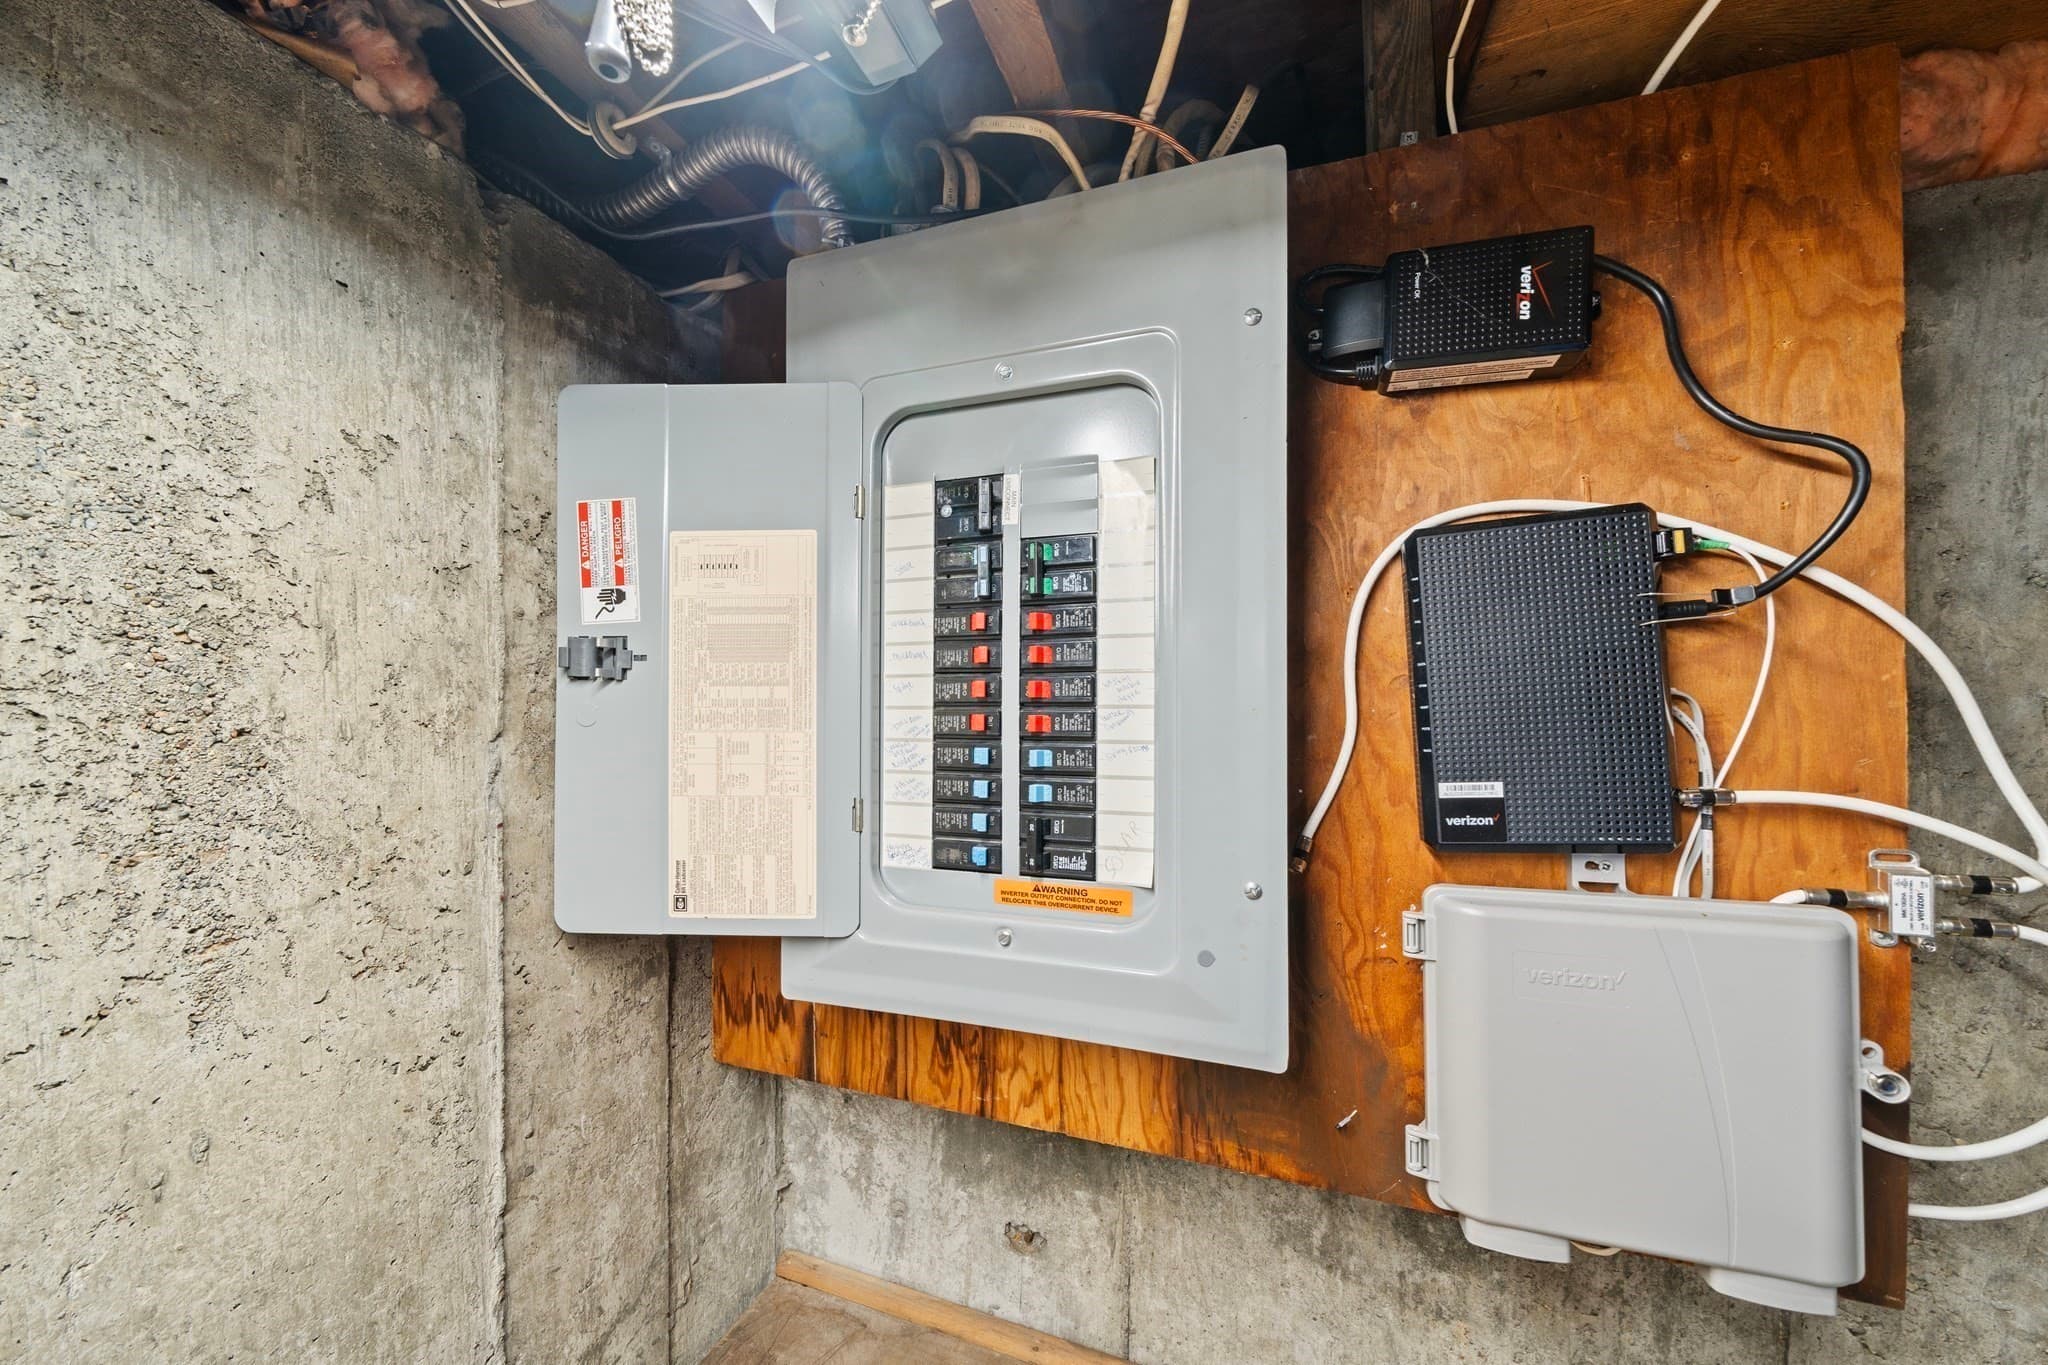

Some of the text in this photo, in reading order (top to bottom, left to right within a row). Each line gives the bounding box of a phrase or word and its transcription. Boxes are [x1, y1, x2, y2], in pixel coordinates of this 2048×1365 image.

[1515, 265, 1535, 320] verizon
[580, 520, 589, 558] DANGER
[614, 516, 623, 556] PELIGRO
[1445, 815, 1494, 826] verizon
[1000, 890, 1029, 898] INVERTER
[1030, 893, 1054, 901] OUTPUT
[1041, 885, 1088, 897] WARNING
[1001, 897, 1032, 905] RELOCATE
[1048, 901, 1094, 911] OVERCURRENT
[1095, 906, 1120, 914] DEVICE.
[1917, 892, 1925, 922] verizon
[1525, 967, 1617, 991] verizon
